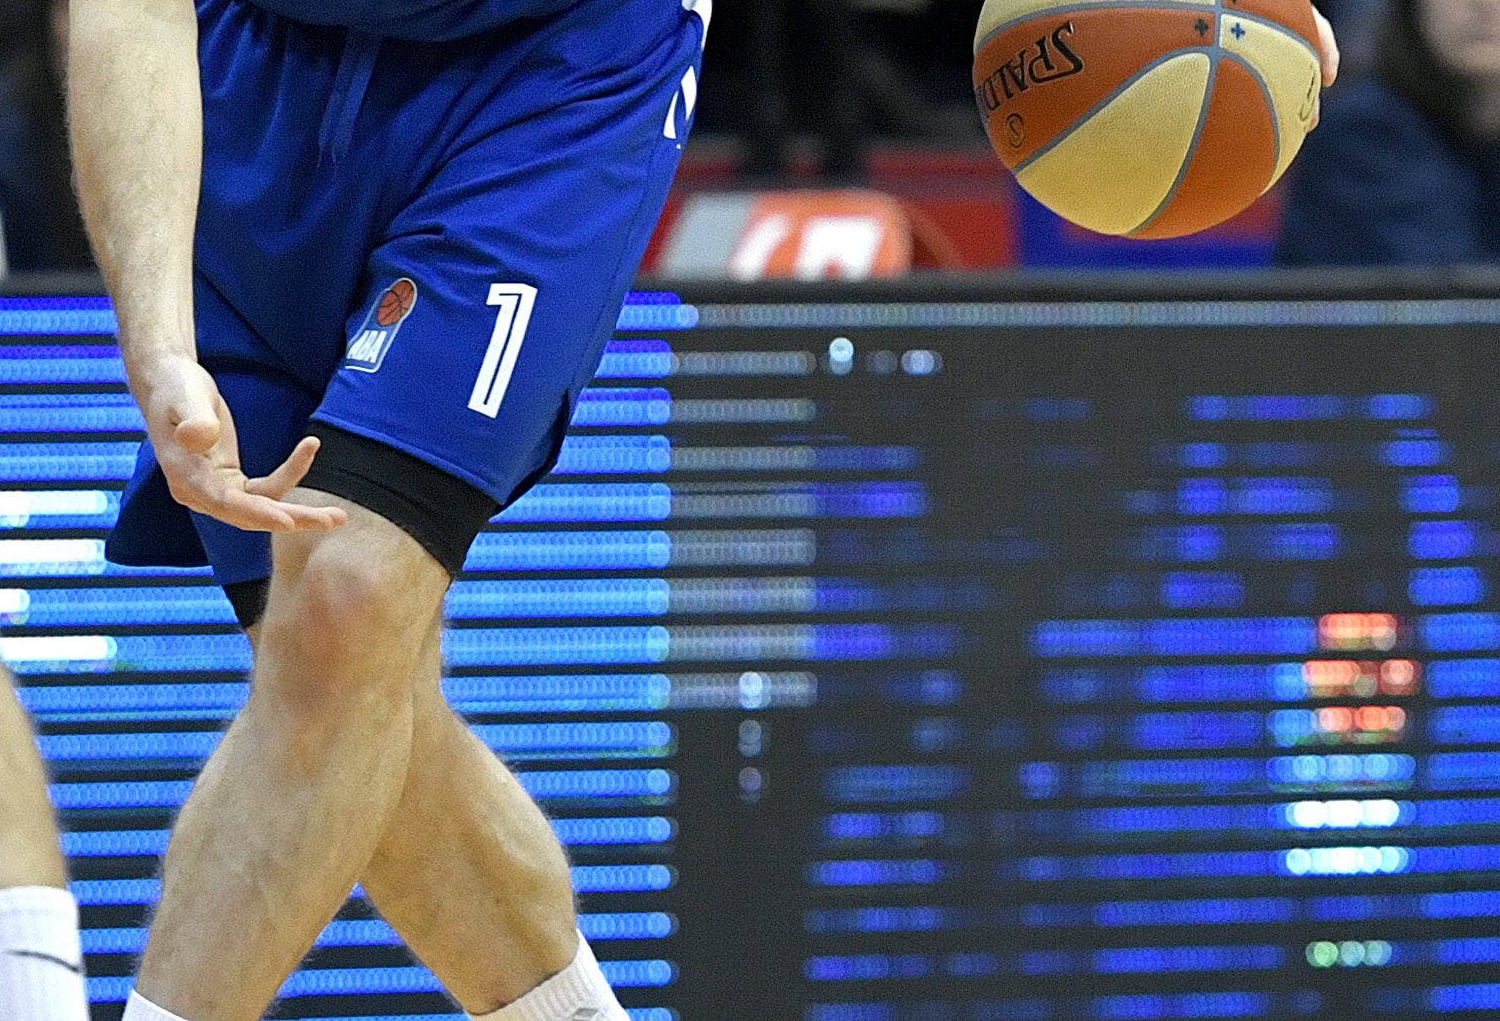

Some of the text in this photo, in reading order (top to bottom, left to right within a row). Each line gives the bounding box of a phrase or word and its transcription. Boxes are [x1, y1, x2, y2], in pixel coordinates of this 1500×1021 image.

[978, 19, 1085, 116] SPALD
[345, 329, 388, 365] ABA
[466, 282, 538, 419] 1
